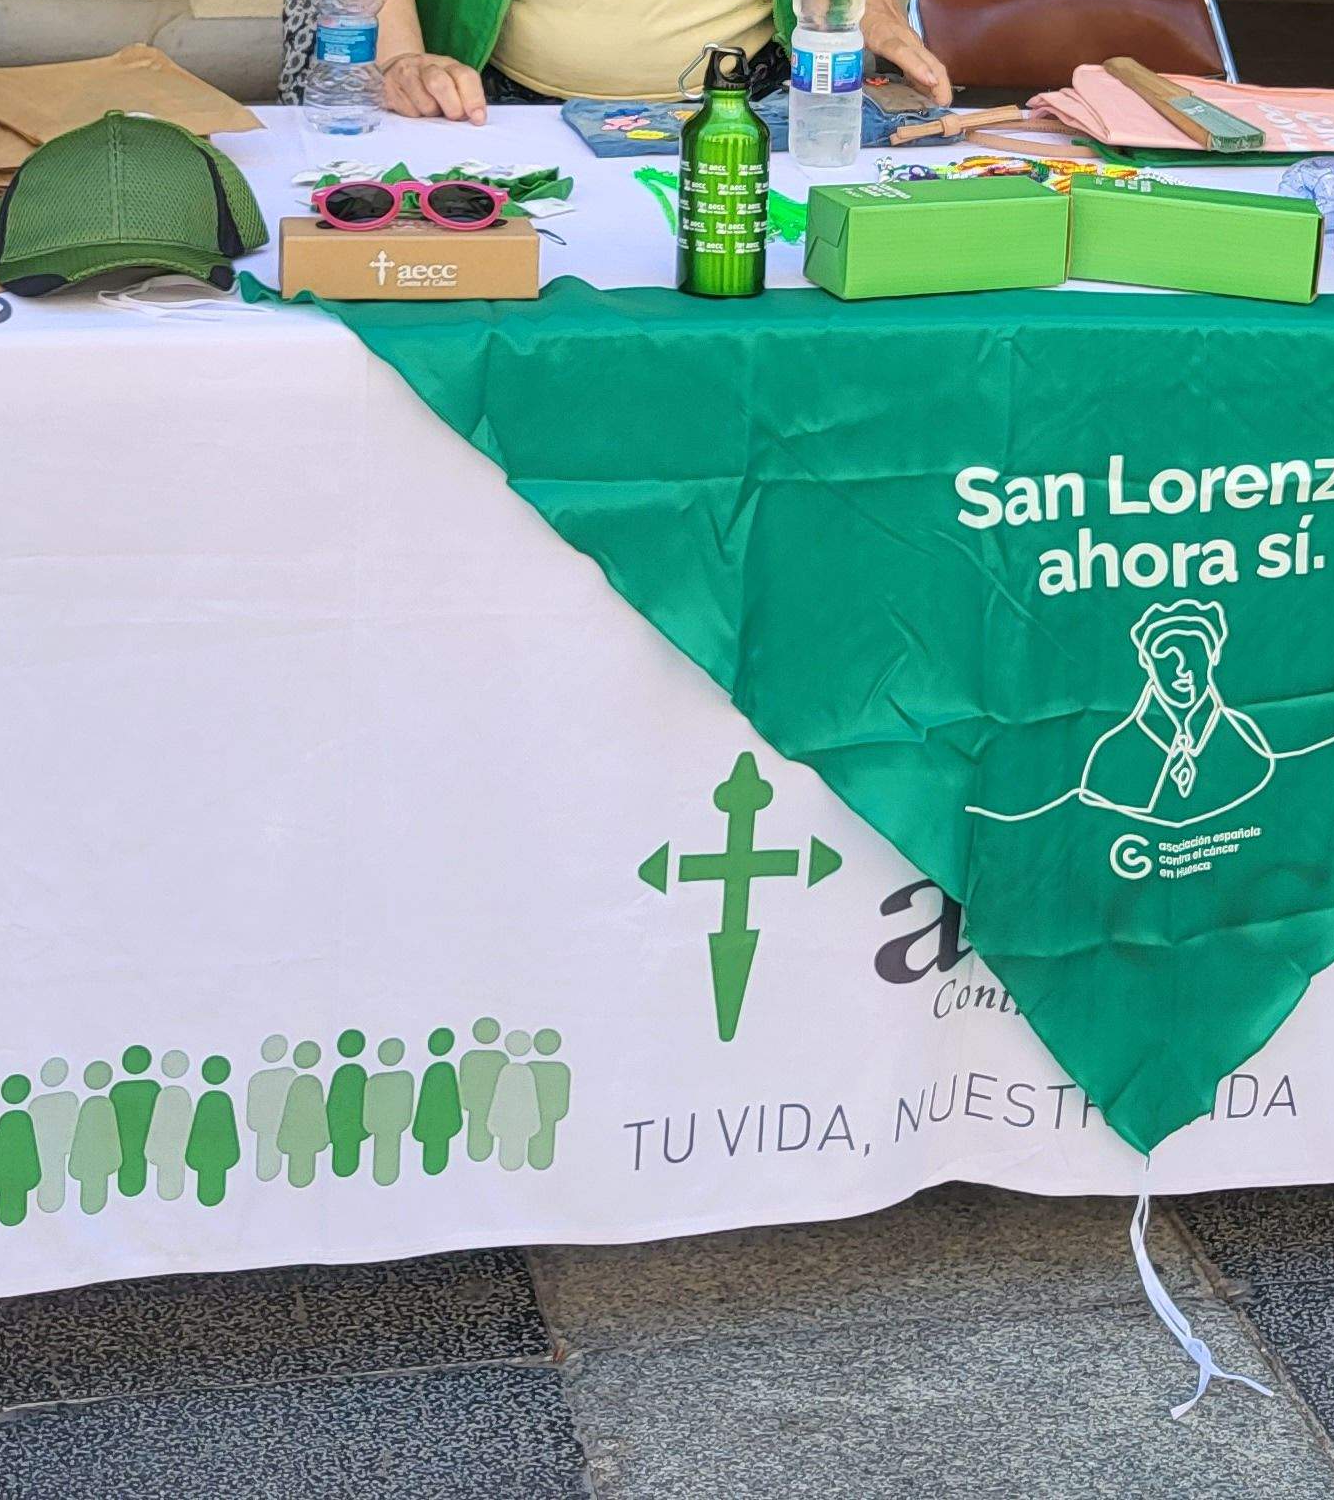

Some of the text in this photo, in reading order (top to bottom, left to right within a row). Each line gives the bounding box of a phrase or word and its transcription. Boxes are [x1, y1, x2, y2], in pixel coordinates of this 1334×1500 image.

[397, 264, 458, 279] aecc
[954, 465, 1086, 529] San
[1038, 514, 1325, 596] ahora sí.
[1158, 825, 1262, 853] asociación española
[1158, 844, 1240, 866] contra el cáncer
[1159, 861, 1212, 879] en Huesca
[933, 978, 1021, 1019] Cont
[623, 1112, 696, 1171] TU
[717, 1102, 871, 1157] VIDA,
[894, 1071, 1098, 1144] NUEST
